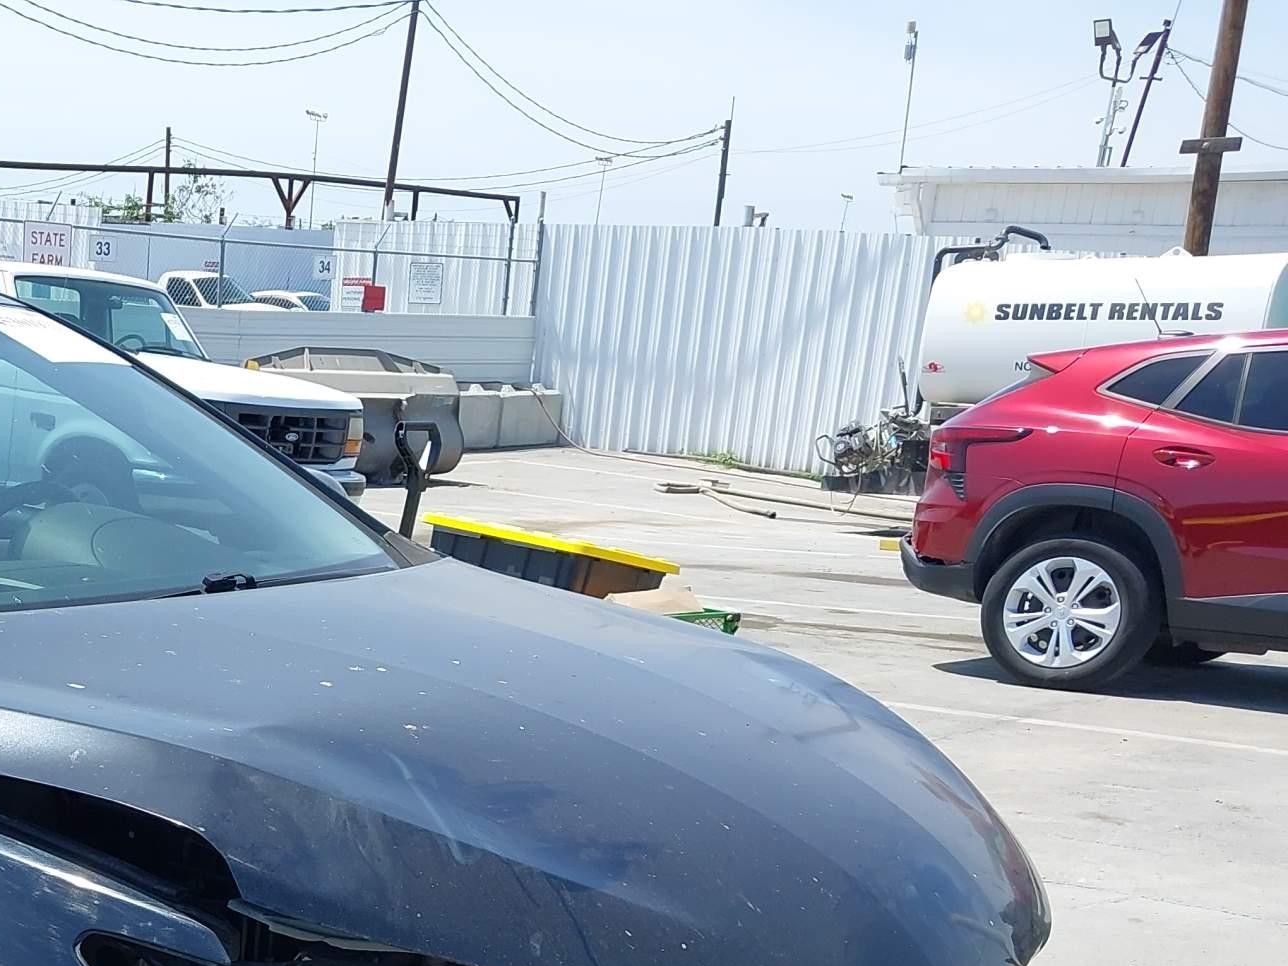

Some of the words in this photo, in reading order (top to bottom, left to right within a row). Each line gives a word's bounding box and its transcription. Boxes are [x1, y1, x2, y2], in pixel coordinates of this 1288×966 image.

[31, 230, 66, 247] STATE
[95, 241, 111, 256] 33
[31, 252, 63, 266] FARM
[318, 260, 331, 274] 34
[994, 302, 1103, 321] SUNBELT
[1107, 302, 1224, 321] RENTALS
